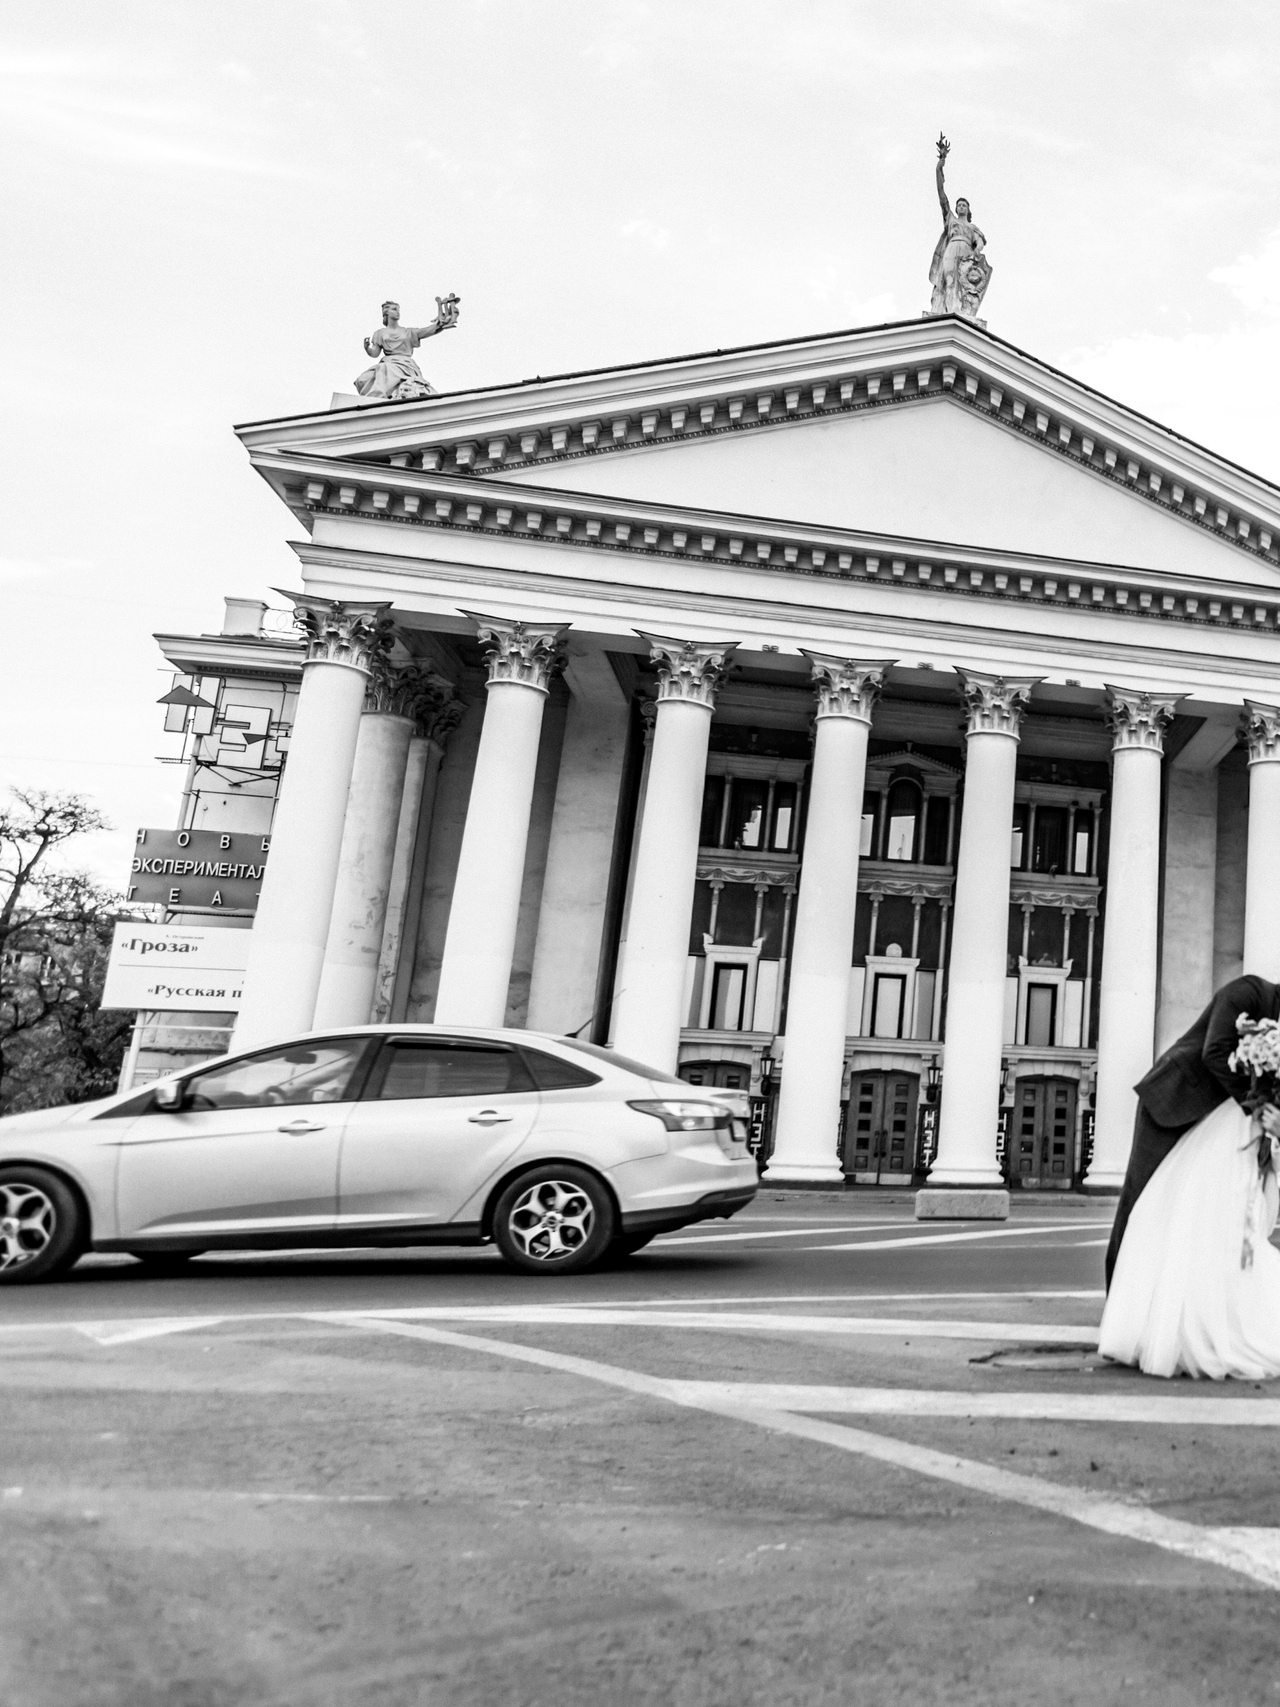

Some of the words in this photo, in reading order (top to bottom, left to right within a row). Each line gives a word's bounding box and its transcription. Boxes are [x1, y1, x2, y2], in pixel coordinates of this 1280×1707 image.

[164, 673, 291, 770] НЭ
[128, 885, 261, 905] ТЕА
[121, 938, 199, 954] «Гроза»
[147, 984, 226, 998] «Русская
